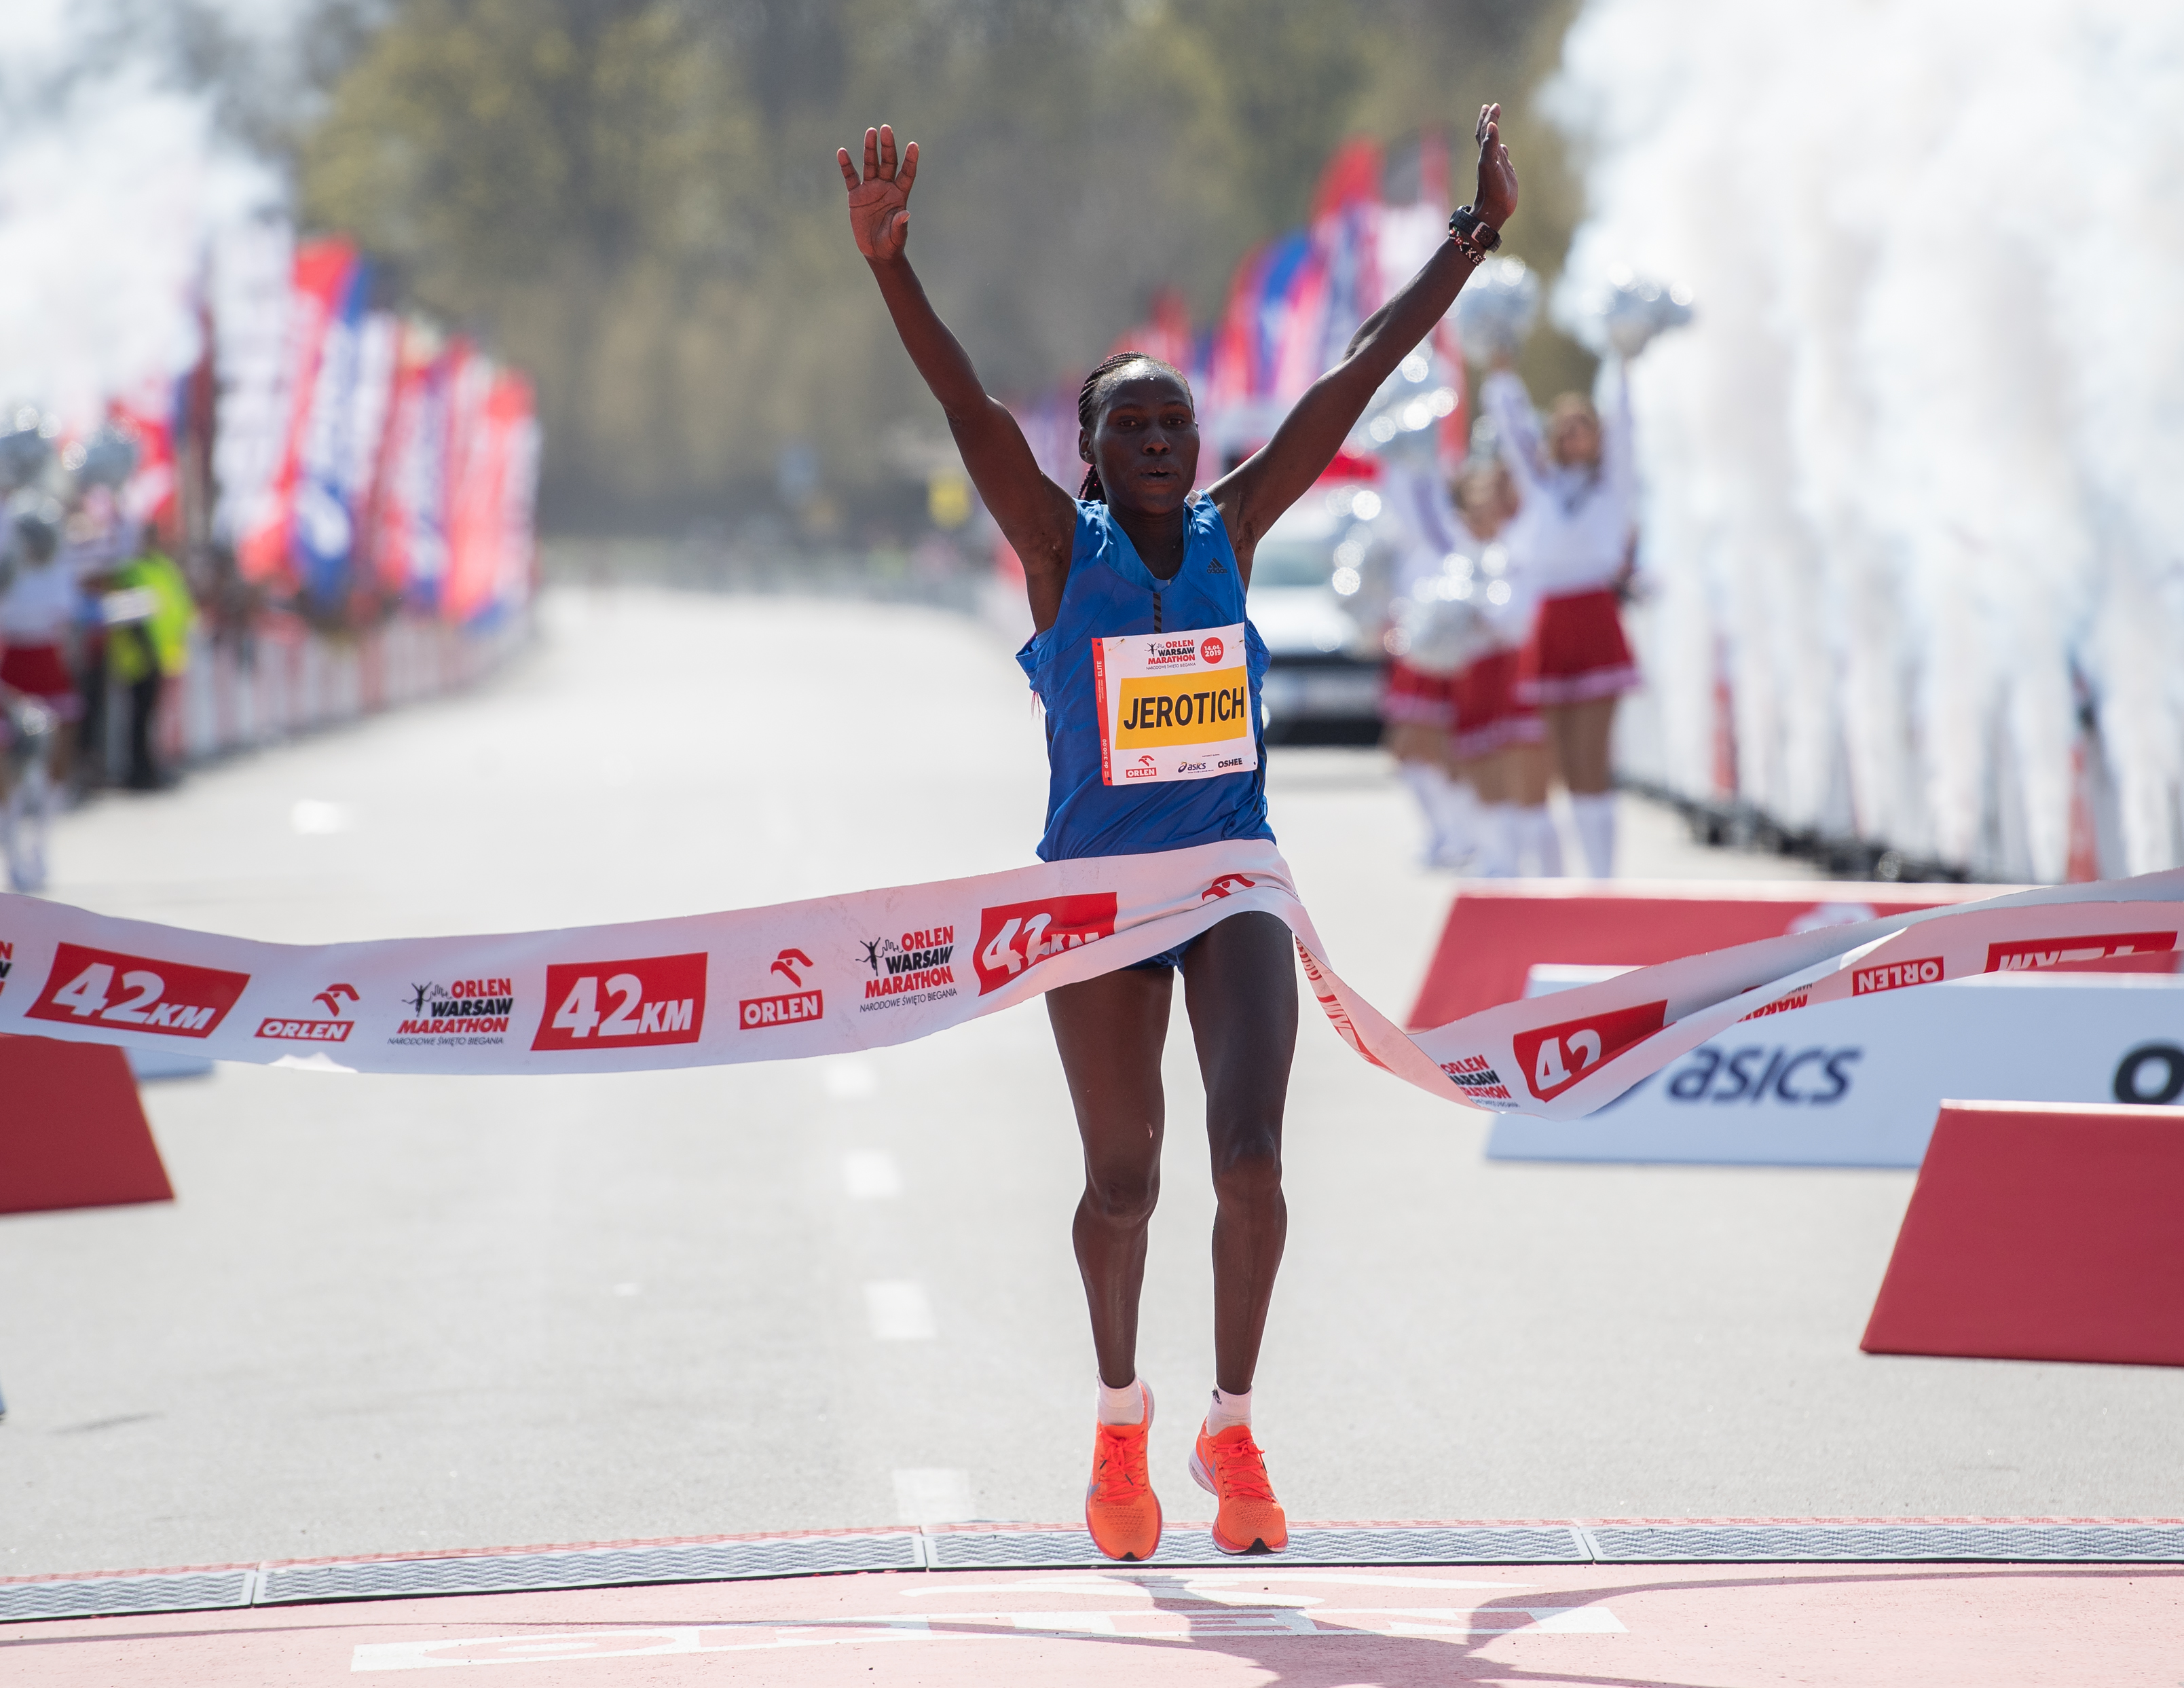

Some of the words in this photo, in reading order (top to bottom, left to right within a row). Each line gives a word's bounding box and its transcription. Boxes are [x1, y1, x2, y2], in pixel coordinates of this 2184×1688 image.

[1158, 646, 1195, 657] WARSAW
[1166, 639, 1194, 648] ORLEN
[1204, 649, 1222, 657] 2019
[1148, 654, 1196, 665] MARATHON
[1123, 686, 1244, 730] JEROTICH
[1103, 760, 1109, 769] do
[1127, 769, 1155, 777] ORLEN
[1187, 763, 1206, 771] asics
[1217, 758, 1243, 768] OSHEE
[901, 925, 954, 952] ORLEN
[885, 945, 955, 974] WARSAW
[865, 966, 955, 999] MARATHON
[1858, 960, 1940, 993] ORLEN
[51, 961, 216, 1031] 42KM
[450, 978, 511, 999] ORLEN
[430, 998, 514, 1017] WARSAW
[551, 973, 694, 1038] 42KM
[859, 997, 902, 1013] NARODOWE
[902, 991, 927, 1007] ŚWIĘTO
[927, 987, 958, 1002] BIEGANIA
[744, 995, 819, 1026] ORLEN
[262, 1021, 348, 1040] ORLEN
[396, 1017, 510, 1034] MARATHON
[387, 1037, 436, 1046] NARODOWE
[436, 1035, 466, 1048] ŚWIĘTO
[467, 1037, 504, 1046] BIEGANIA
[1440, 1054, 1490, 1075] ORLEN
[1668, 1044, 1864, 1107] asics
